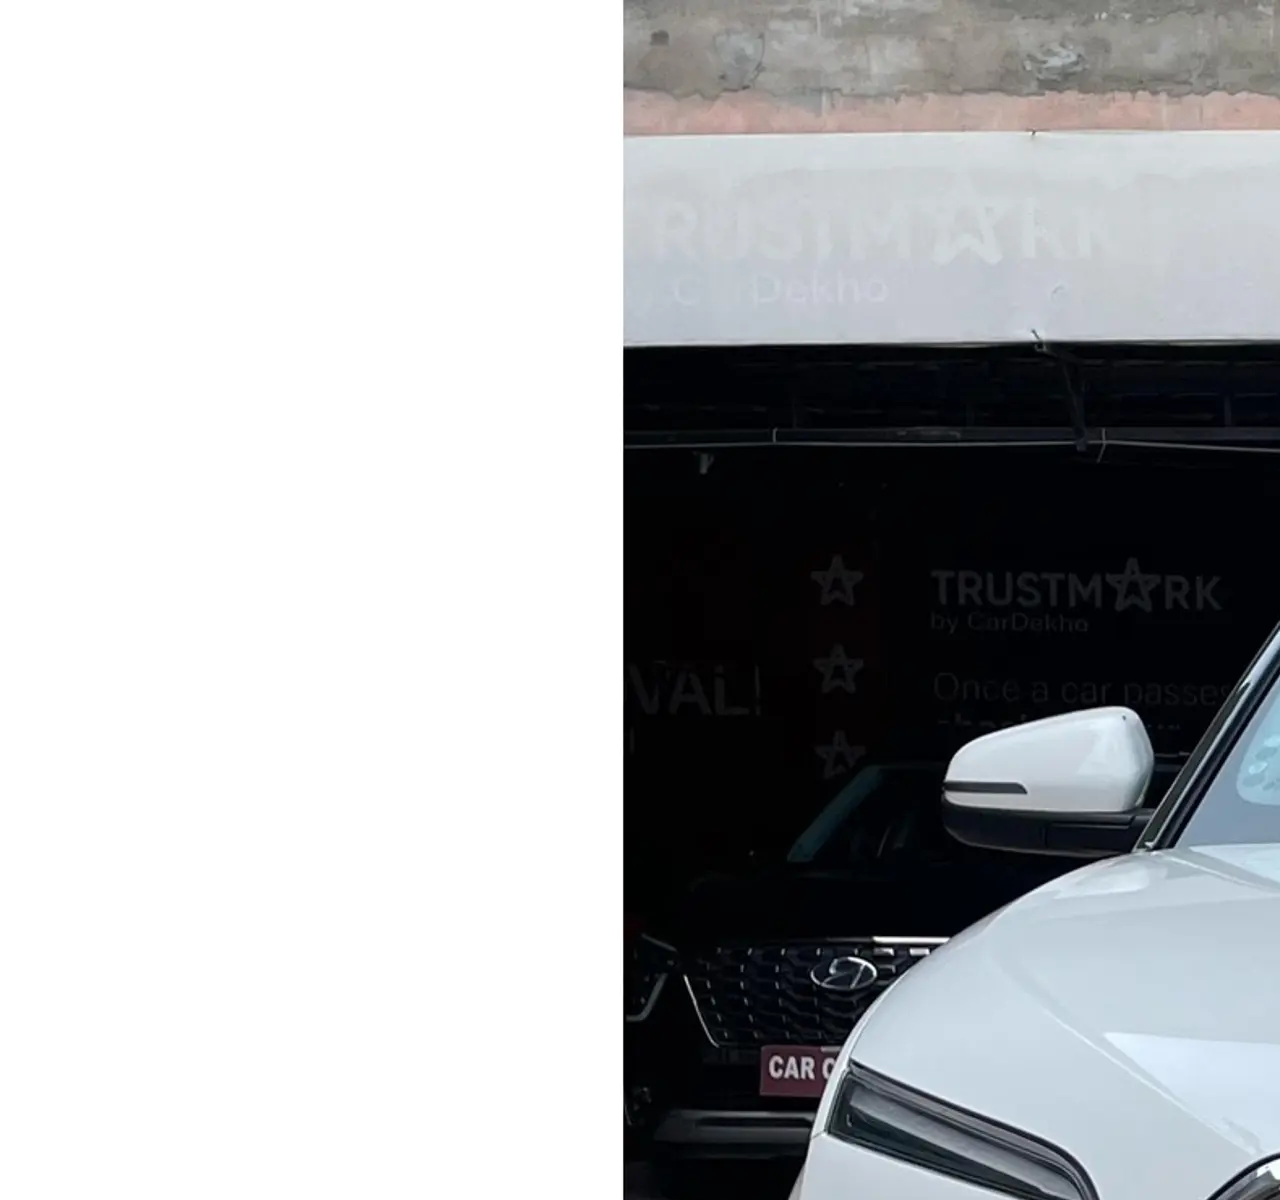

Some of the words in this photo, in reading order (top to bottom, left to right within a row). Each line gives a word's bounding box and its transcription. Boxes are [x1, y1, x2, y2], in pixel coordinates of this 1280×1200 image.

[930, 611, 960, 635] by
[967, 612, 1090, 634] CarDekho
[933, 672, 1021, 703] Once
[1031, 681, 1050, 704] a
[1061, 681, 1113, 705] car
[768, 1055, 815, 1080] CAR
